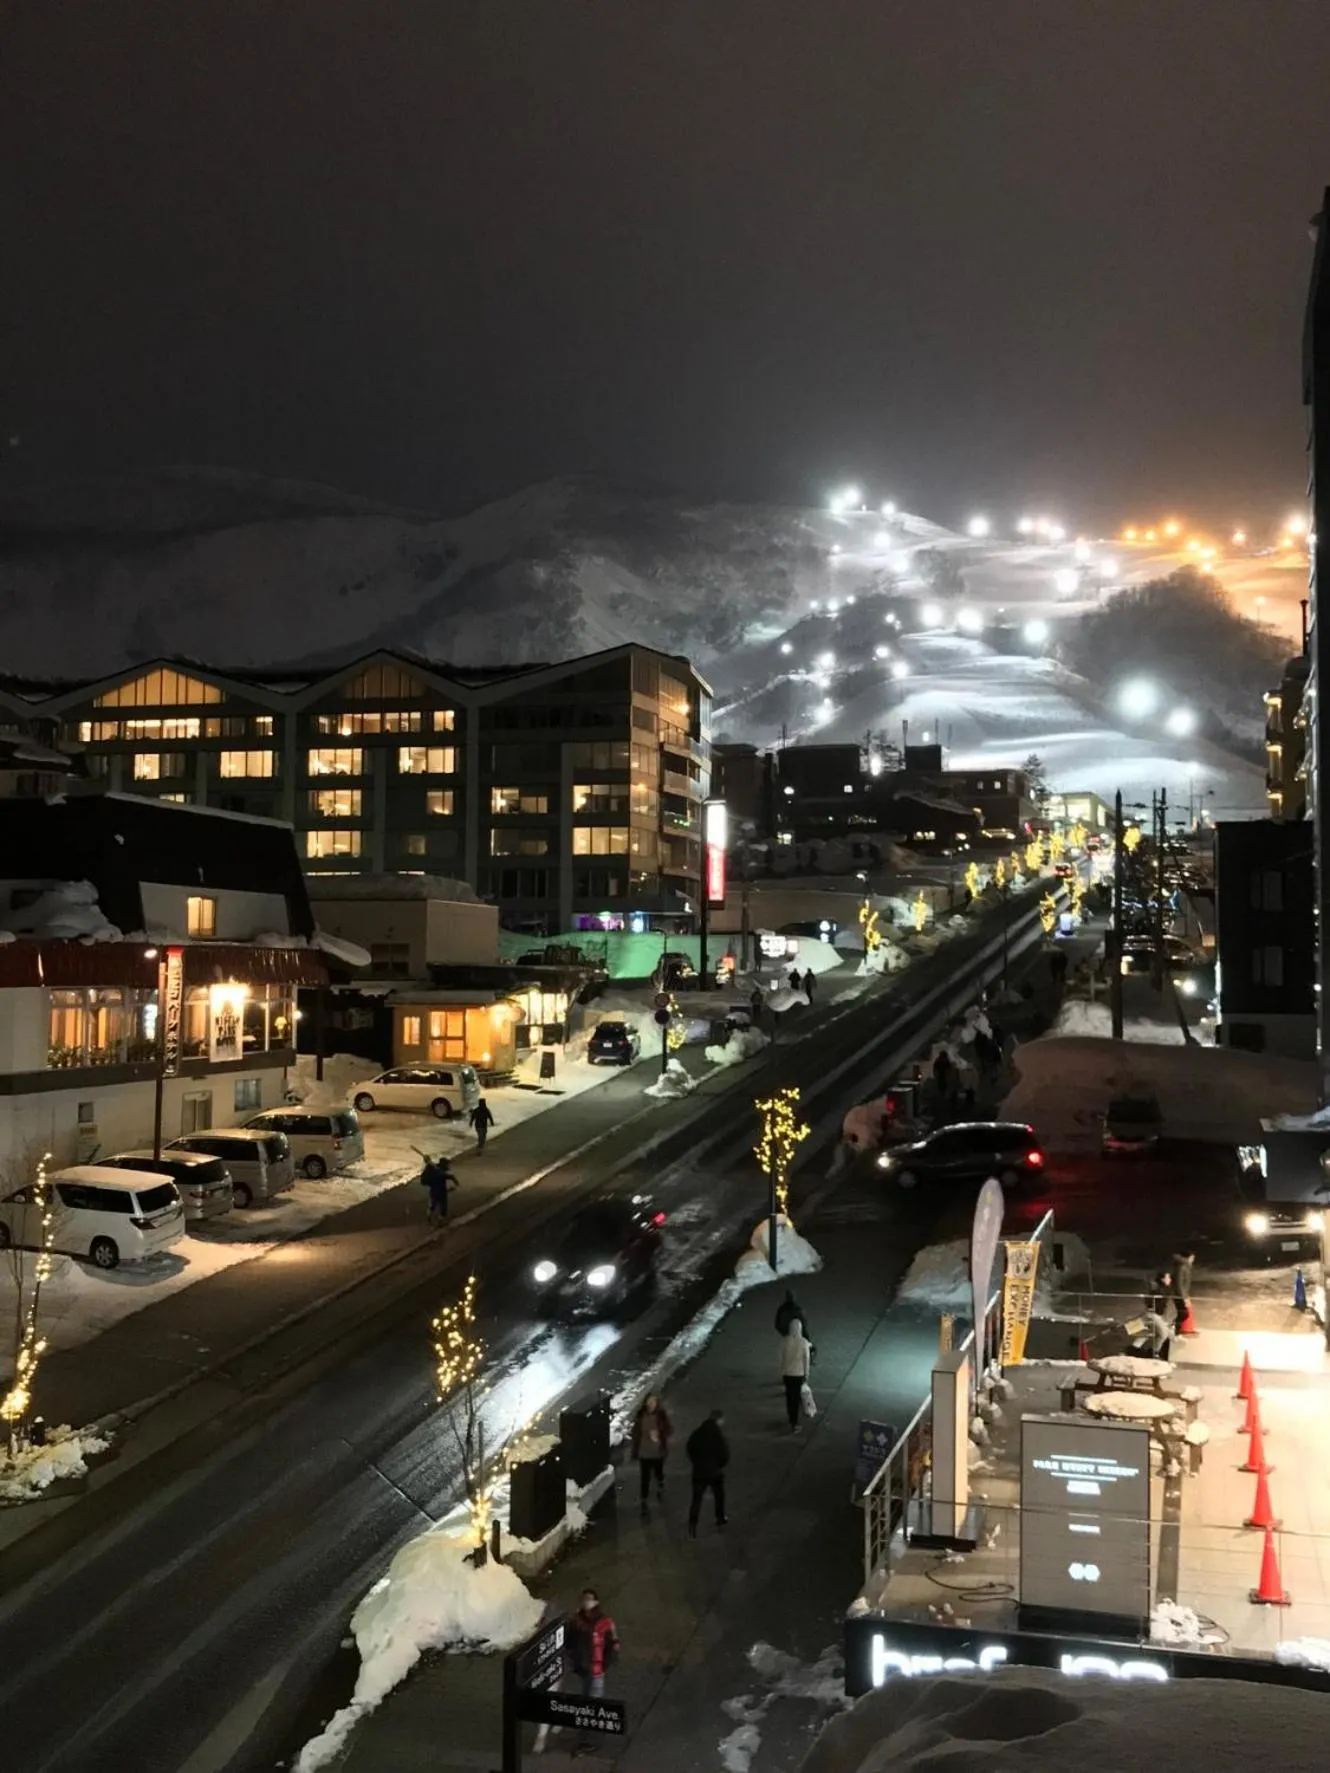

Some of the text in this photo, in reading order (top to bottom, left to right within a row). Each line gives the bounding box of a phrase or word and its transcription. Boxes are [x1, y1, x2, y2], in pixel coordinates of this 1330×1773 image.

[1002, 1284, 1019, 1360] EXCHANGE
[1018, 1285, 1031, 1327] MONEY
[550, 1700, 595, 1716] Sasayaki
